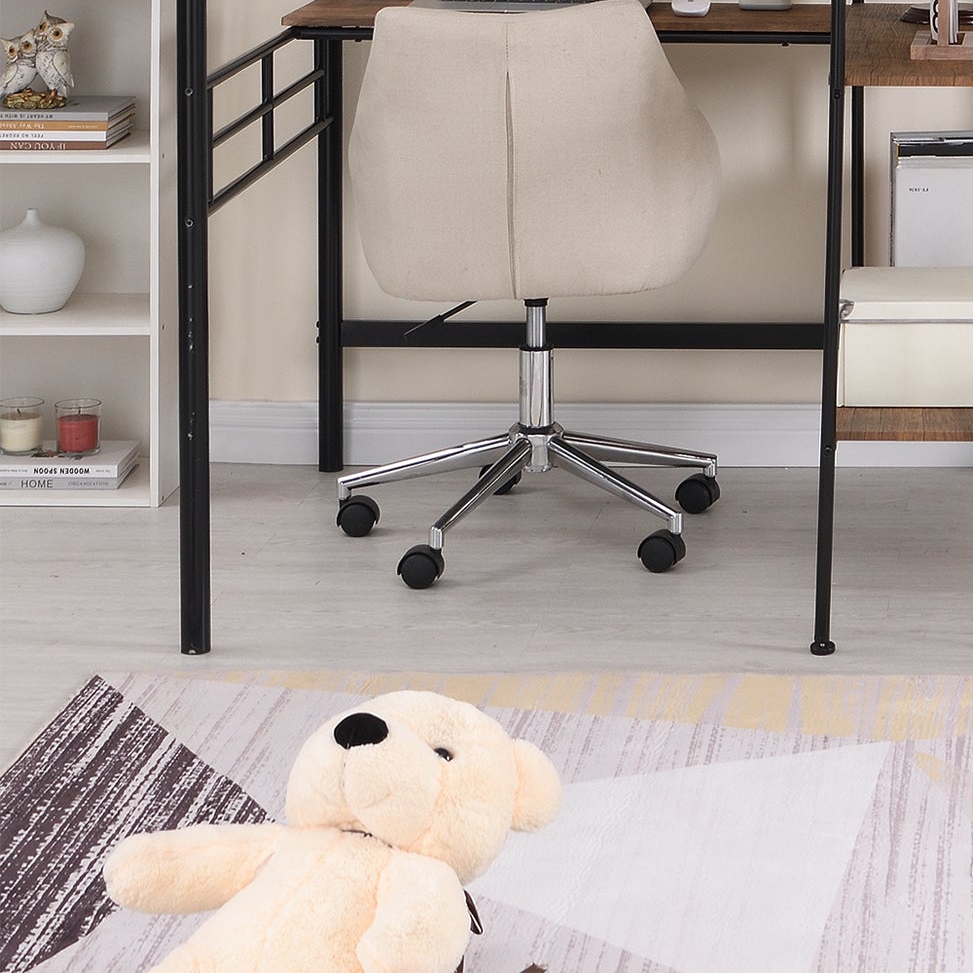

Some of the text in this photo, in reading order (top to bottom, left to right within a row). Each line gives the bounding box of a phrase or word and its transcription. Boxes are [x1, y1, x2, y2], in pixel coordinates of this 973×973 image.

[10, 142, 66, 150] IF YOU CAN
[20, 479, 54, 489] HOME
